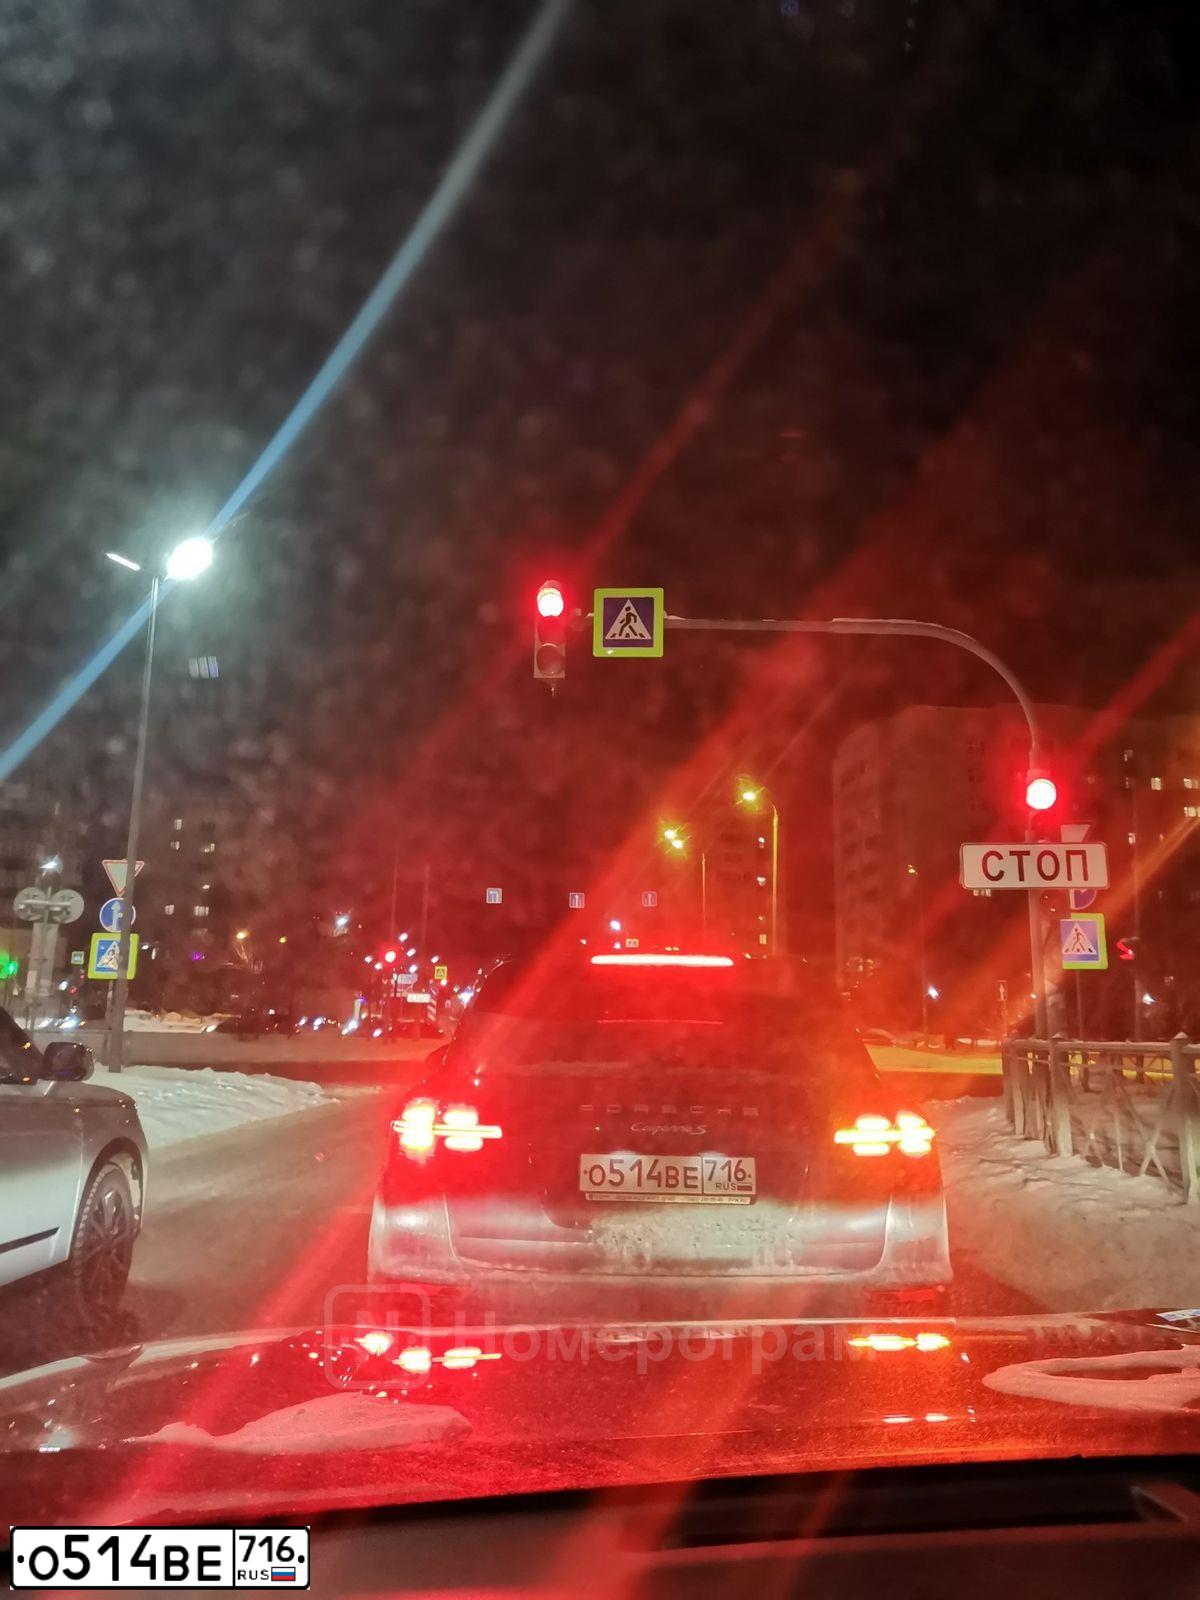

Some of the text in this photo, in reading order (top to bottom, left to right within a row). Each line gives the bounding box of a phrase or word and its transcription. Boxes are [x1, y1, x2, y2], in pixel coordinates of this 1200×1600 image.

[981, 849, 1089, 882] СТОП
[588, 1158, 747, 1189] О514ВЕ 716
[715, 1182, 737, 1191] RUS
